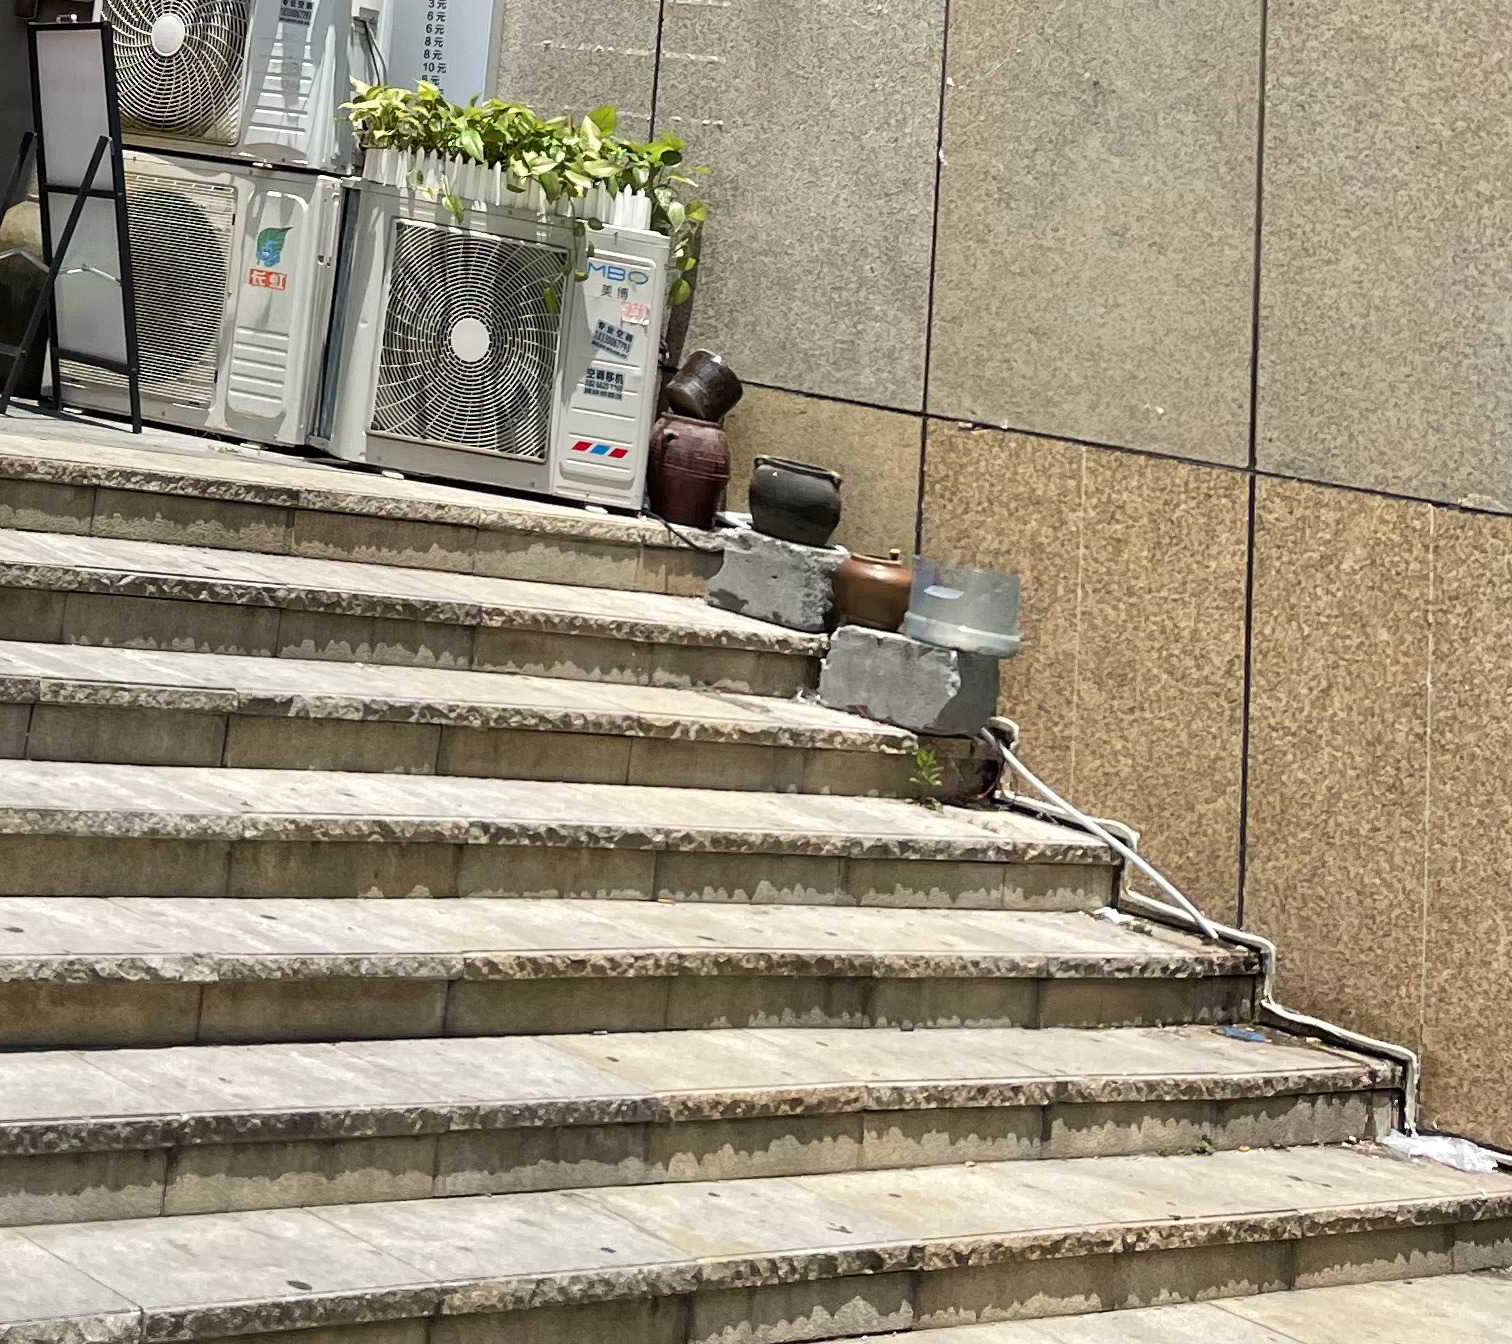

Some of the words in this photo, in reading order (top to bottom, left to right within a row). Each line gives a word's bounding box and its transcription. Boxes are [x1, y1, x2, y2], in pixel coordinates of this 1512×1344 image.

[250, 269, 286, 290] 长虹
[588, 262, 649, 285] MBO
[600, 284, 630, 300] 美博
